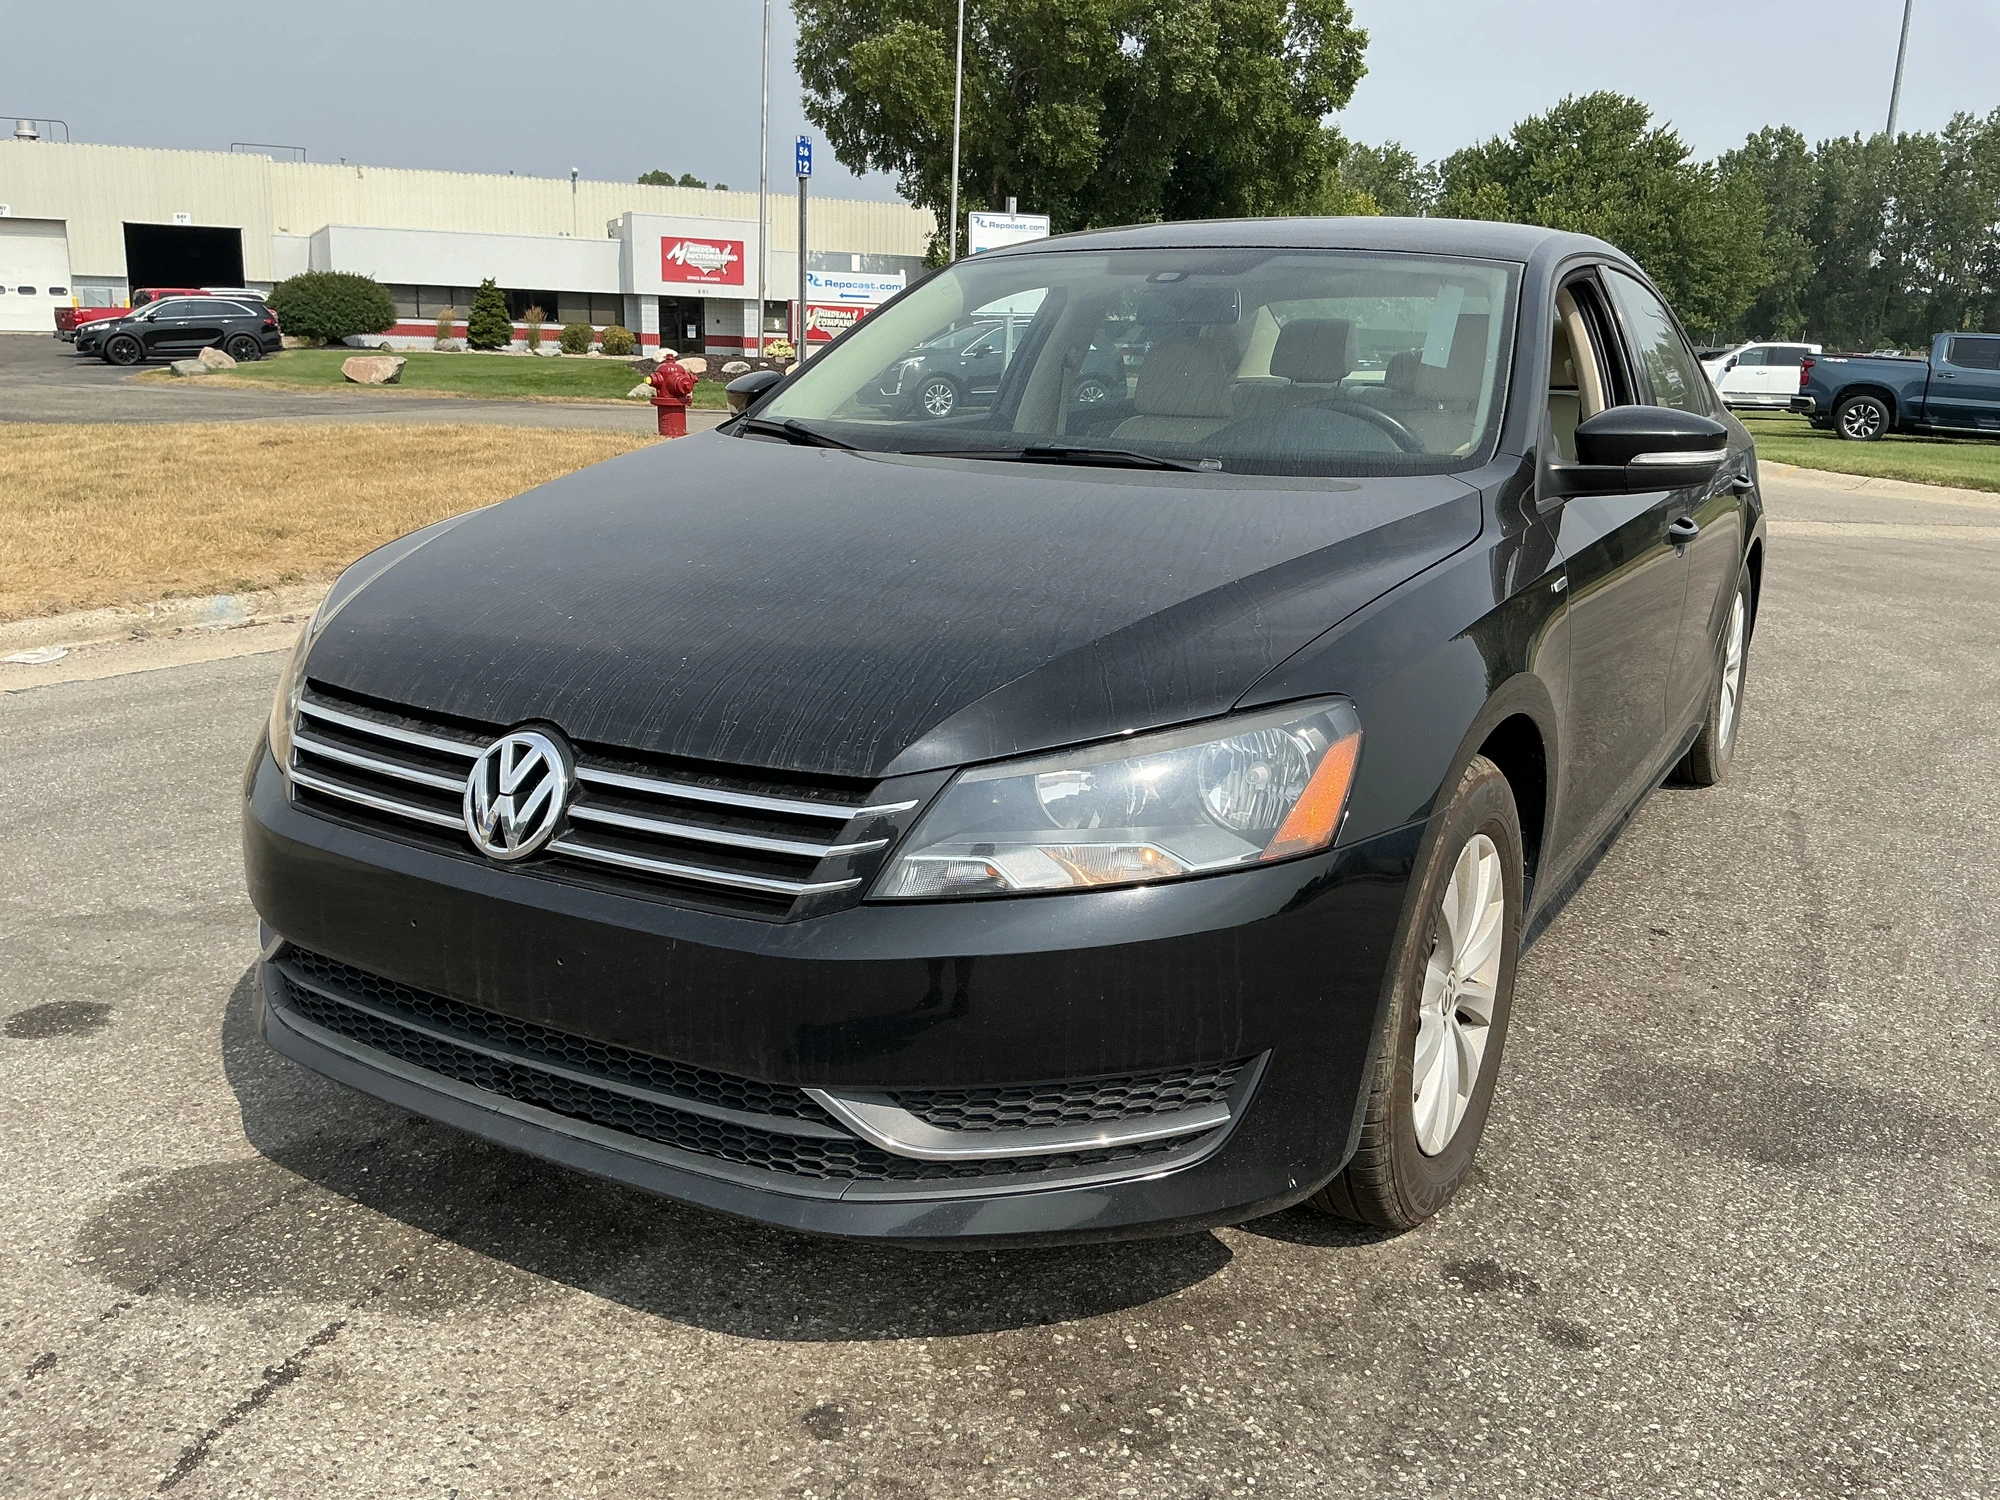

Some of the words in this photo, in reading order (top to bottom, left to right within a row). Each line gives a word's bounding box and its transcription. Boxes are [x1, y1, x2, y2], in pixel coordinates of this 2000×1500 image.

[798, 146, 809, 157] 56
[797, 160, 810, 173] 12
[989, 221, 1045, 231] Repocast.com
[688, 245, 720, 255] MIEDEMA
[686, 253, 738, 262] AUCTIONEERING
[825, 279, 902, 291] Repocast.com
[818, 310, 852, 319] MIEDEMA
